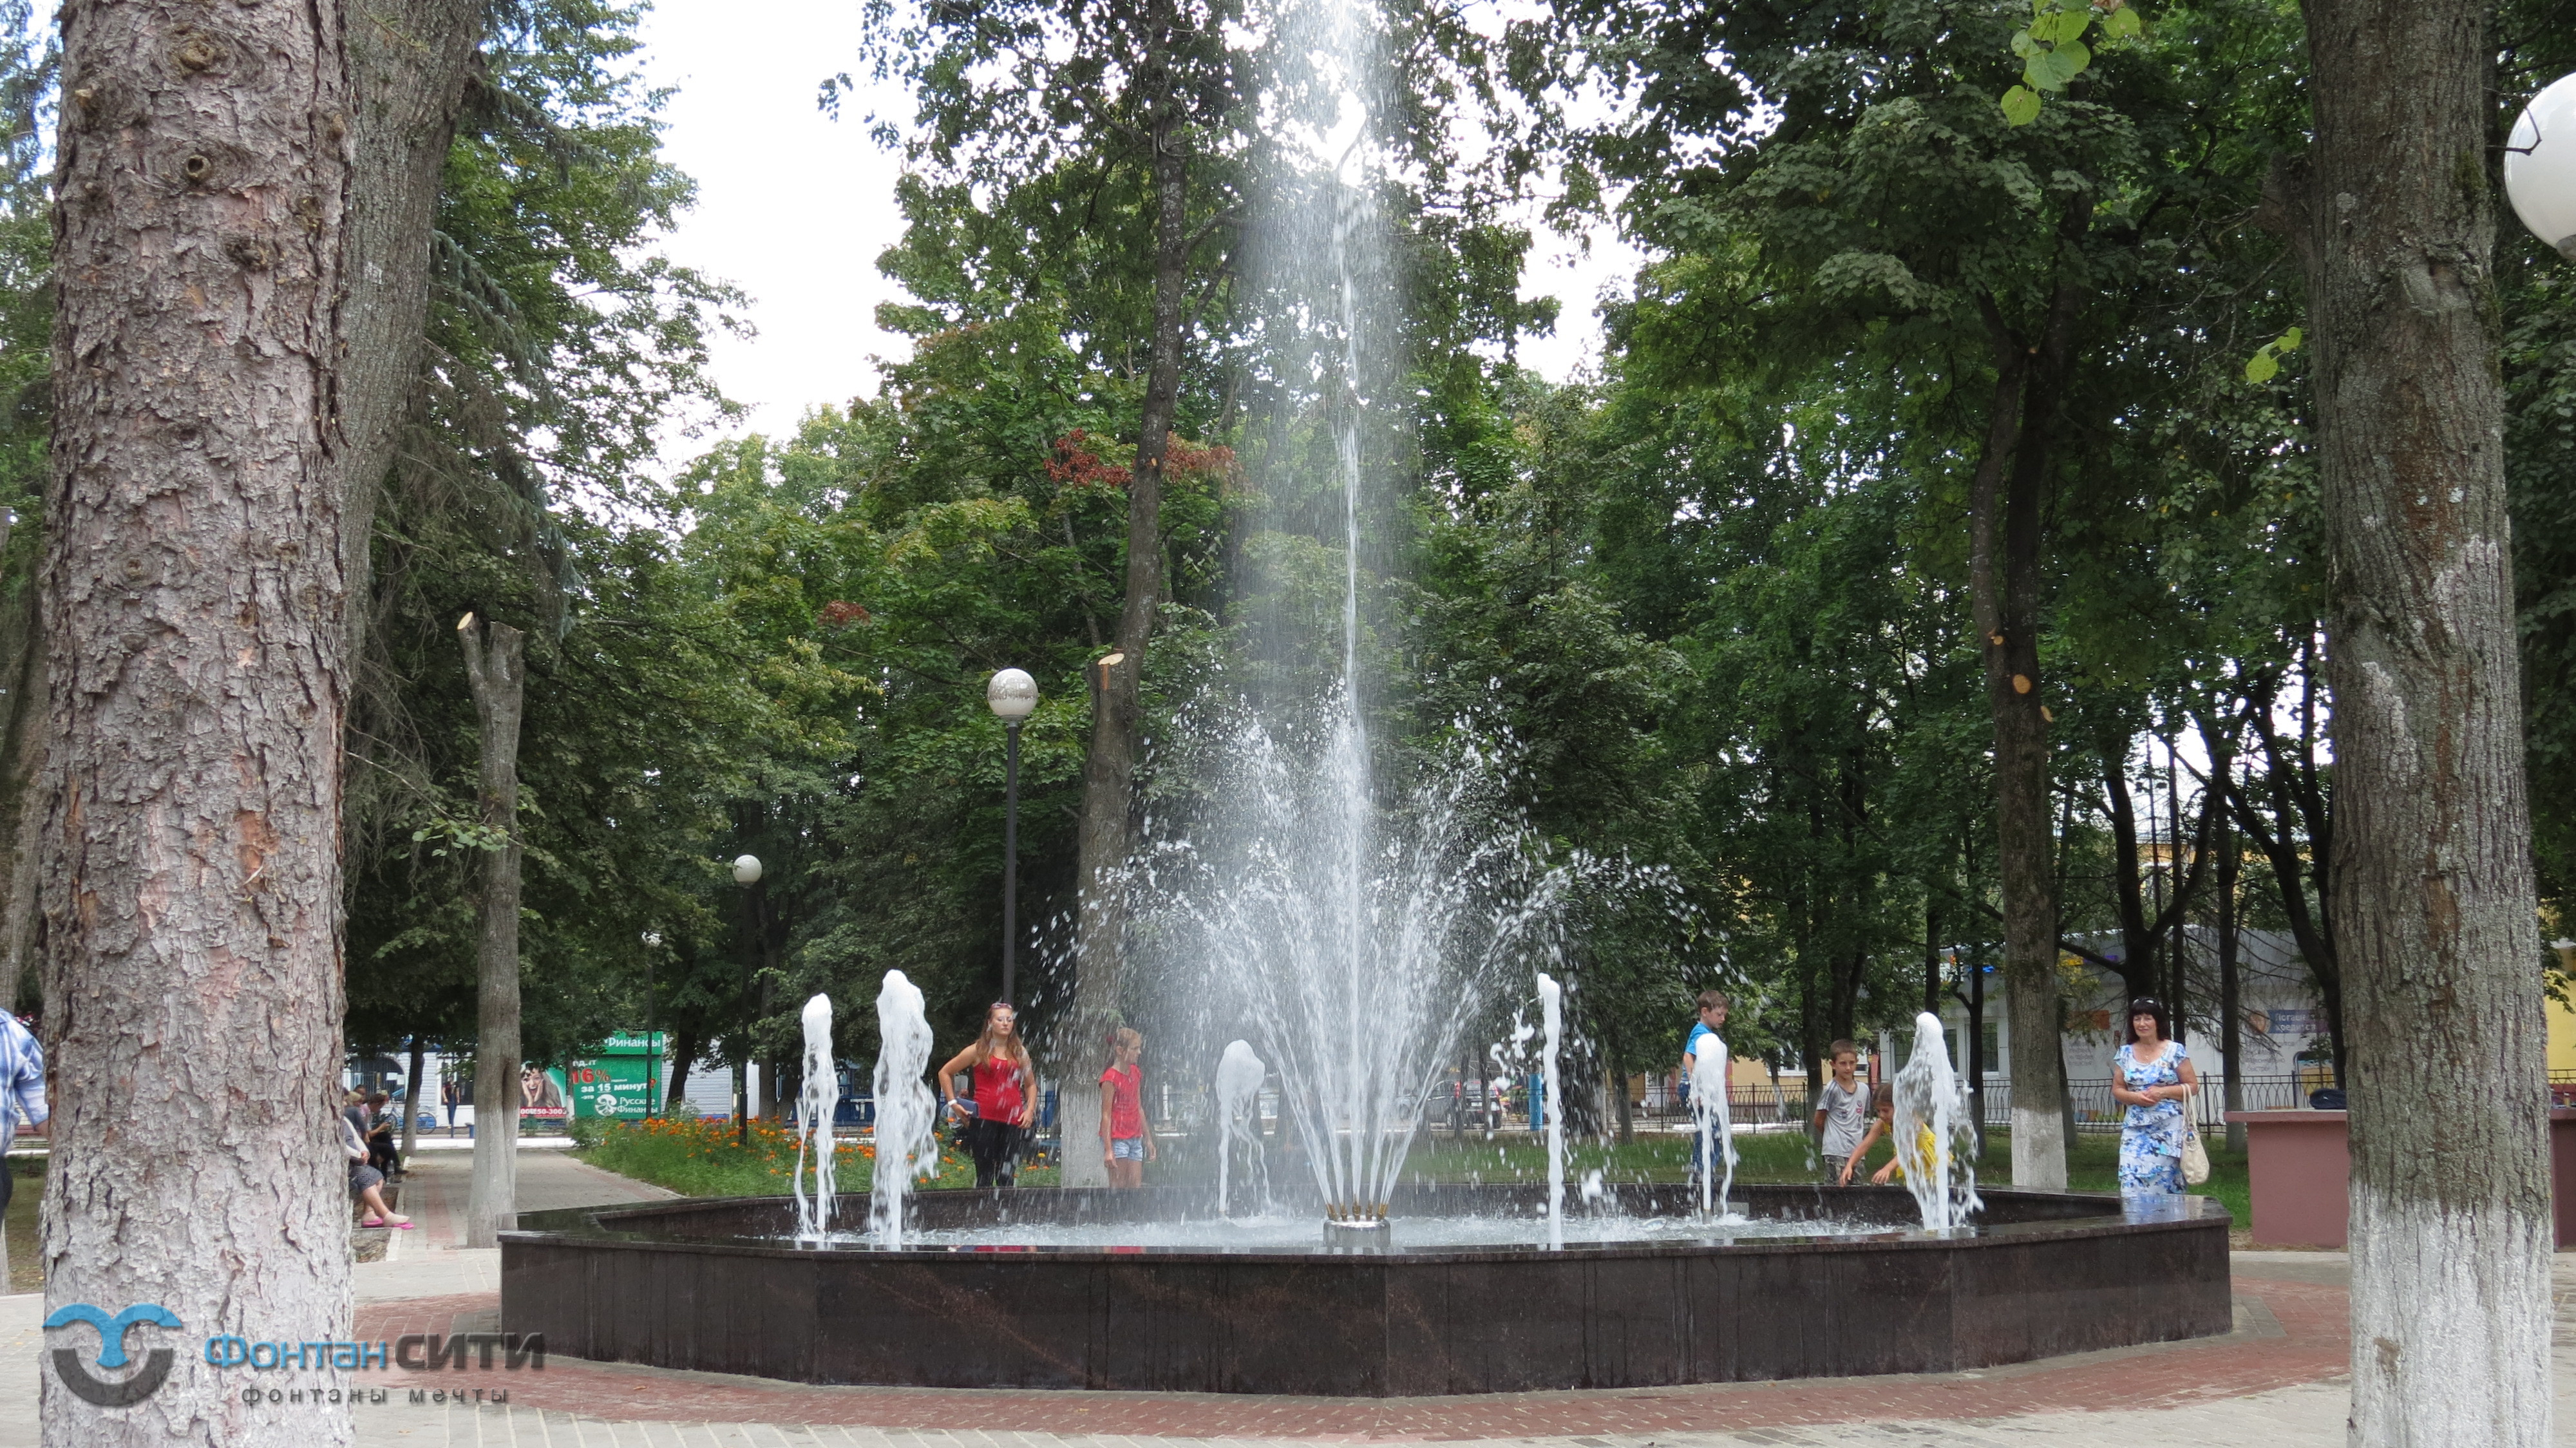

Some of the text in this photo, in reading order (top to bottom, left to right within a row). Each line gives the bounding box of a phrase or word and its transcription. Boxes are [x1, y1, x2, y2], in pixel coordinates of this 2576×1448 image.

[597, 1083, 611, 1092] 15
[620, 1096, 656, 1107] Русске
[617, 1105, 658, 1113] Финаны
